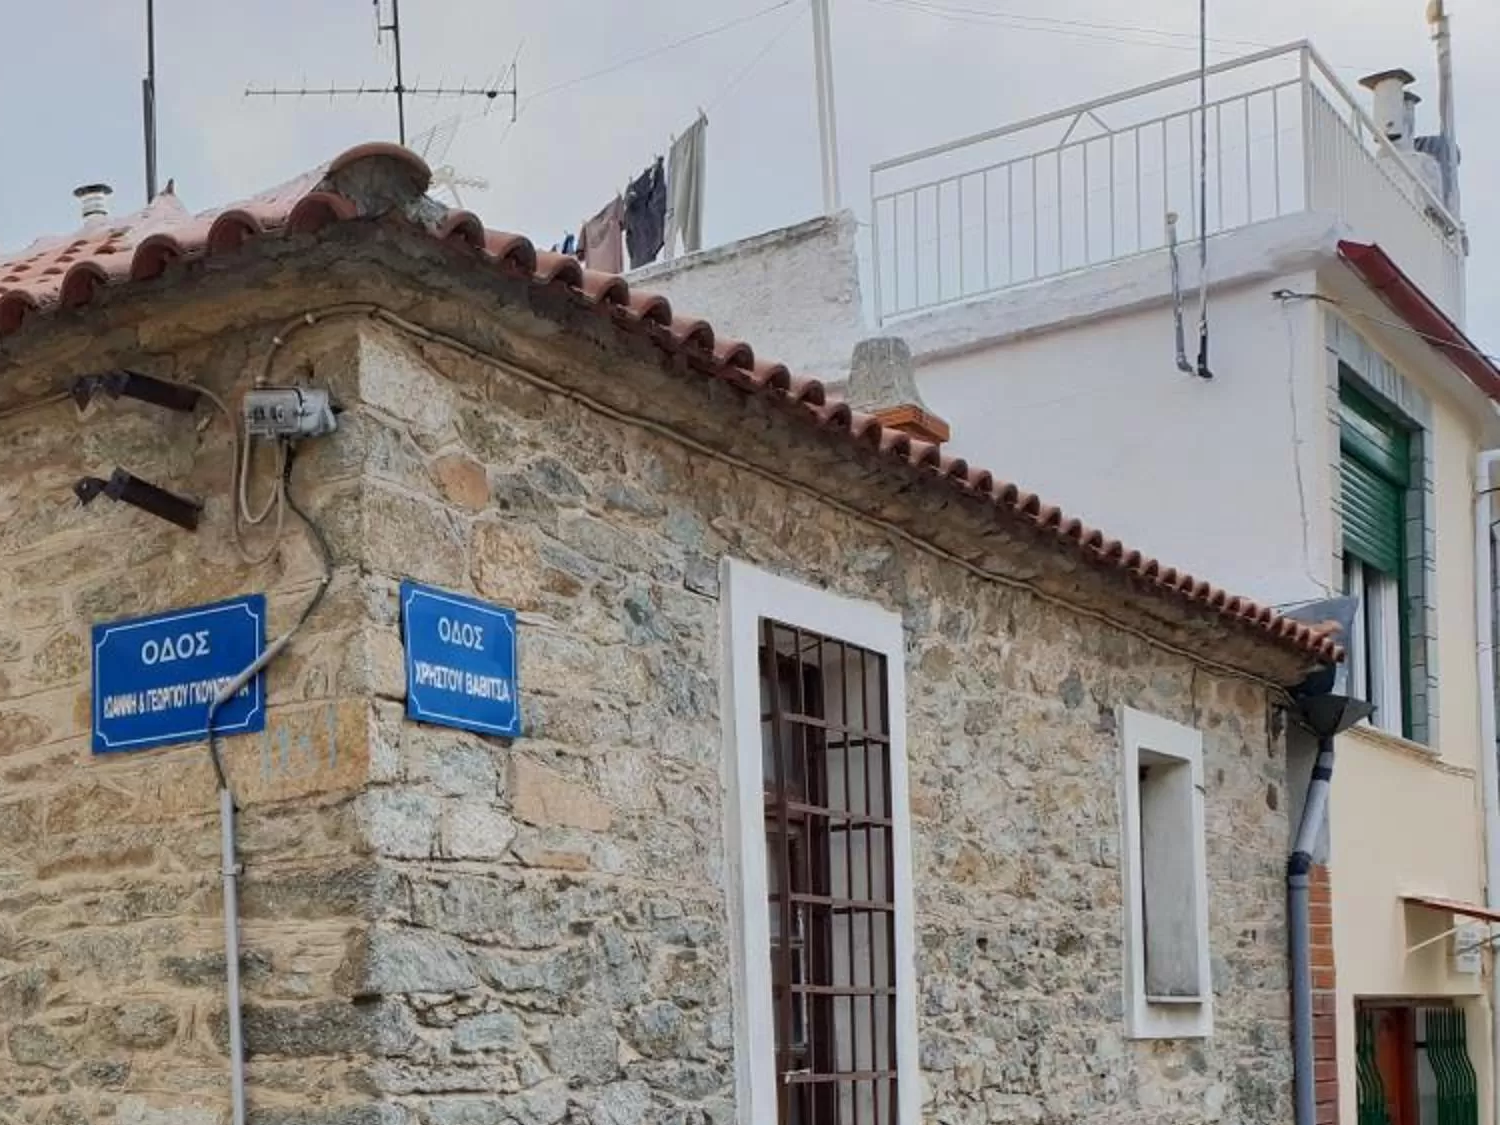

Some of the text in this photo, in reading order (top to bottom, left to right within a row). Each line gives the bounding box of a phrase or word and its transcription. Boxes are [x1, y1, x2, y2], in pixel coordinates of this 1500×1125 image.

[141, 631, 211, 665] ΟΔΟΣ
[437, 616, 484, 651] ΟΔΟΣ
[414, 660, 463, 693] ΧΡΗΣΤΟΥ
